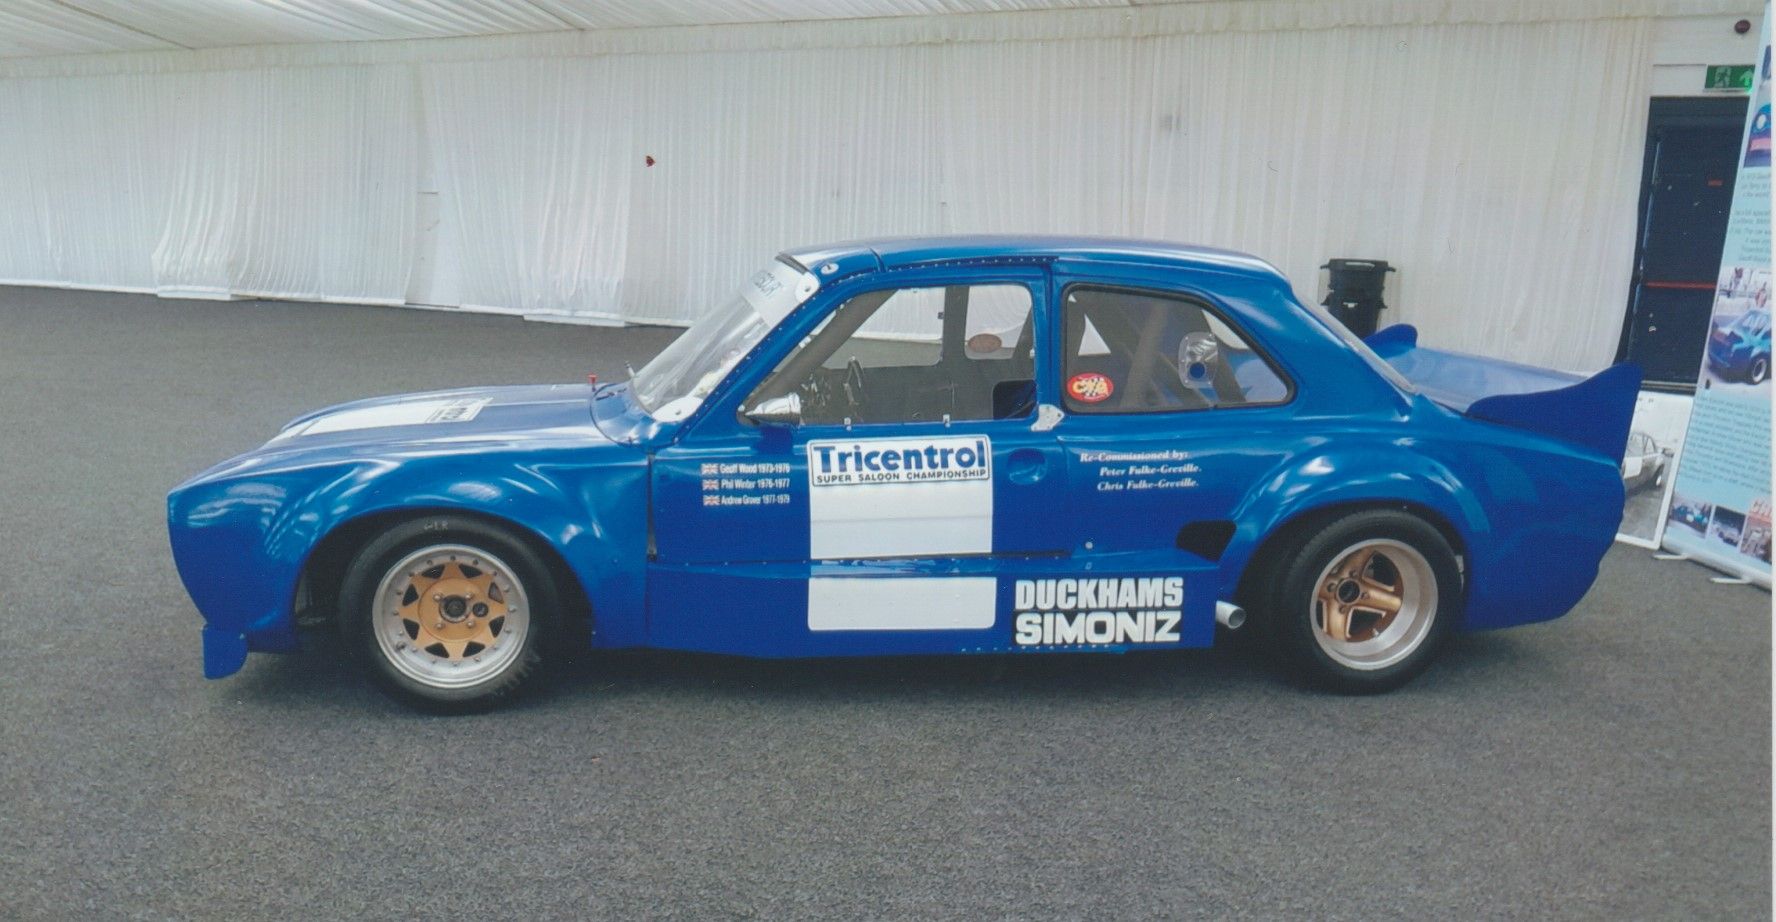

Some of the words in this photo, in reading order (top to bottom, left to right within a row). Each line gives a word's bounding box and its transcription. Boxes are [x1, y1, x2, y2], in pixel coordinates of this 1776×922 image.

[814, 440, 986, 473] Tricentrol
[1079, 451, 1169, 462] Re-Commissioned
[1171, 450, 1189, 461] by:
[719, 463, 738, 473] Geoff
[738, 463, 758, 473] Wood
[1099, 466, 1127, 477] Peter
[1128, 463, 1202, 476] Fulke-Greville.
[816, 474, 852, 483] SUPER
[858, 473, 900, 482] SALOON
[906, 469, 987, 481] CHAMPIONSHIP
[720, 479, 735, 489] Phil
[734, 479, 756, 489] Winter
[757, 478, 790, 489] 1976-1977
[1096, 481, 1124, 491] Chris
[1126, 477, 1199, 490] Fulke-Greville.
[720, 494, 742, 505] Andrew
[1014, 576, 1184, 610] DUCKHAMS
[1015, 610, 1182, 645] SIMONIZ
